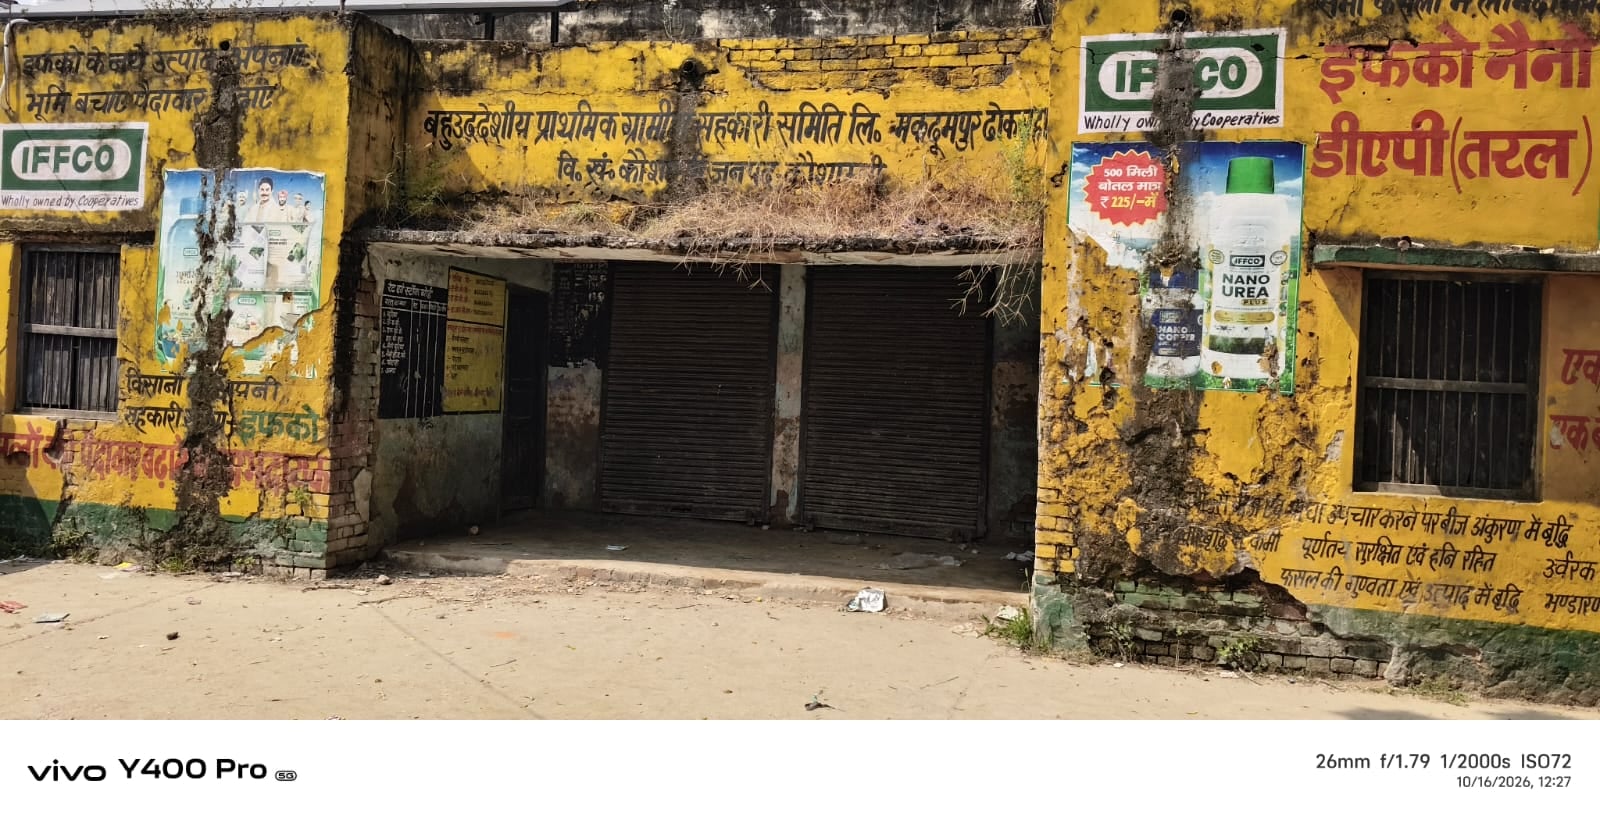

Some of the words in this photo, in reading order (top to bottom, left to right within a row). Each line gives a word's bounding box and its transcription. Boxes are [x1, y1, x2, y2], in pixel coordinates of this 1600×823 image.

[1116, 55, 1248, 93] IFCO
[1319, 20, 1480, 104] इफको
[1485, 19, 1599, 89] नैनो
[26, 84, 72, 122] भूमि
[535, 99, 619, 145] प्राथमिक
[697, 100, 774, 149] सहकारी
[777, 101, 847, 148] समिति
[1084, 115, 1130, 130] Wholly
[1202, 111, 1281, 129] Cooperatives
[22, 144, 115, 174] IFFCO
[1311, 109, 1450, 178] डीएपी
[1099, 180, 1134, 191] बोतल
[1136, 180, 1162, 191] मात्र
[1104, 169, 1122, 177] 500
[1126, 165, 1158, 177] मिली
[1, 195, 30, 208] Wholly
[33, 196, 64, 207] owned
[64, 196, 75, 208] by
[78, 195, 139, 208] Cooperatives
[1222, 273, 1270, 285] NANO
[1222, 285, 1269, 298] UREA
[1158, 326, 1188, 334] NANO
[239, 404, 320, 446] इफको
[1379, 505, 1420, 531] करने
[1421, 512, 1442, 535] पर
[1441, 506, 1471, 536] बीज
[1471, 513, 1525, 544] अंकुरण
[1524, 513, 1543, 542] में
[1355, 535, 1404, 566] सुरक्षित
[1406, 542, 1430, 567] एवं
[1462, 545, 1498, 573] रहित
[1543, 550, 1599, 581] उर्वरक
[1281, 567, 1322, 590] फसल
[1320, 565, 1343, 591] की
[1424, 583, 1474, 610] उत्पाद
[1474, 582, 1494, 607] में
